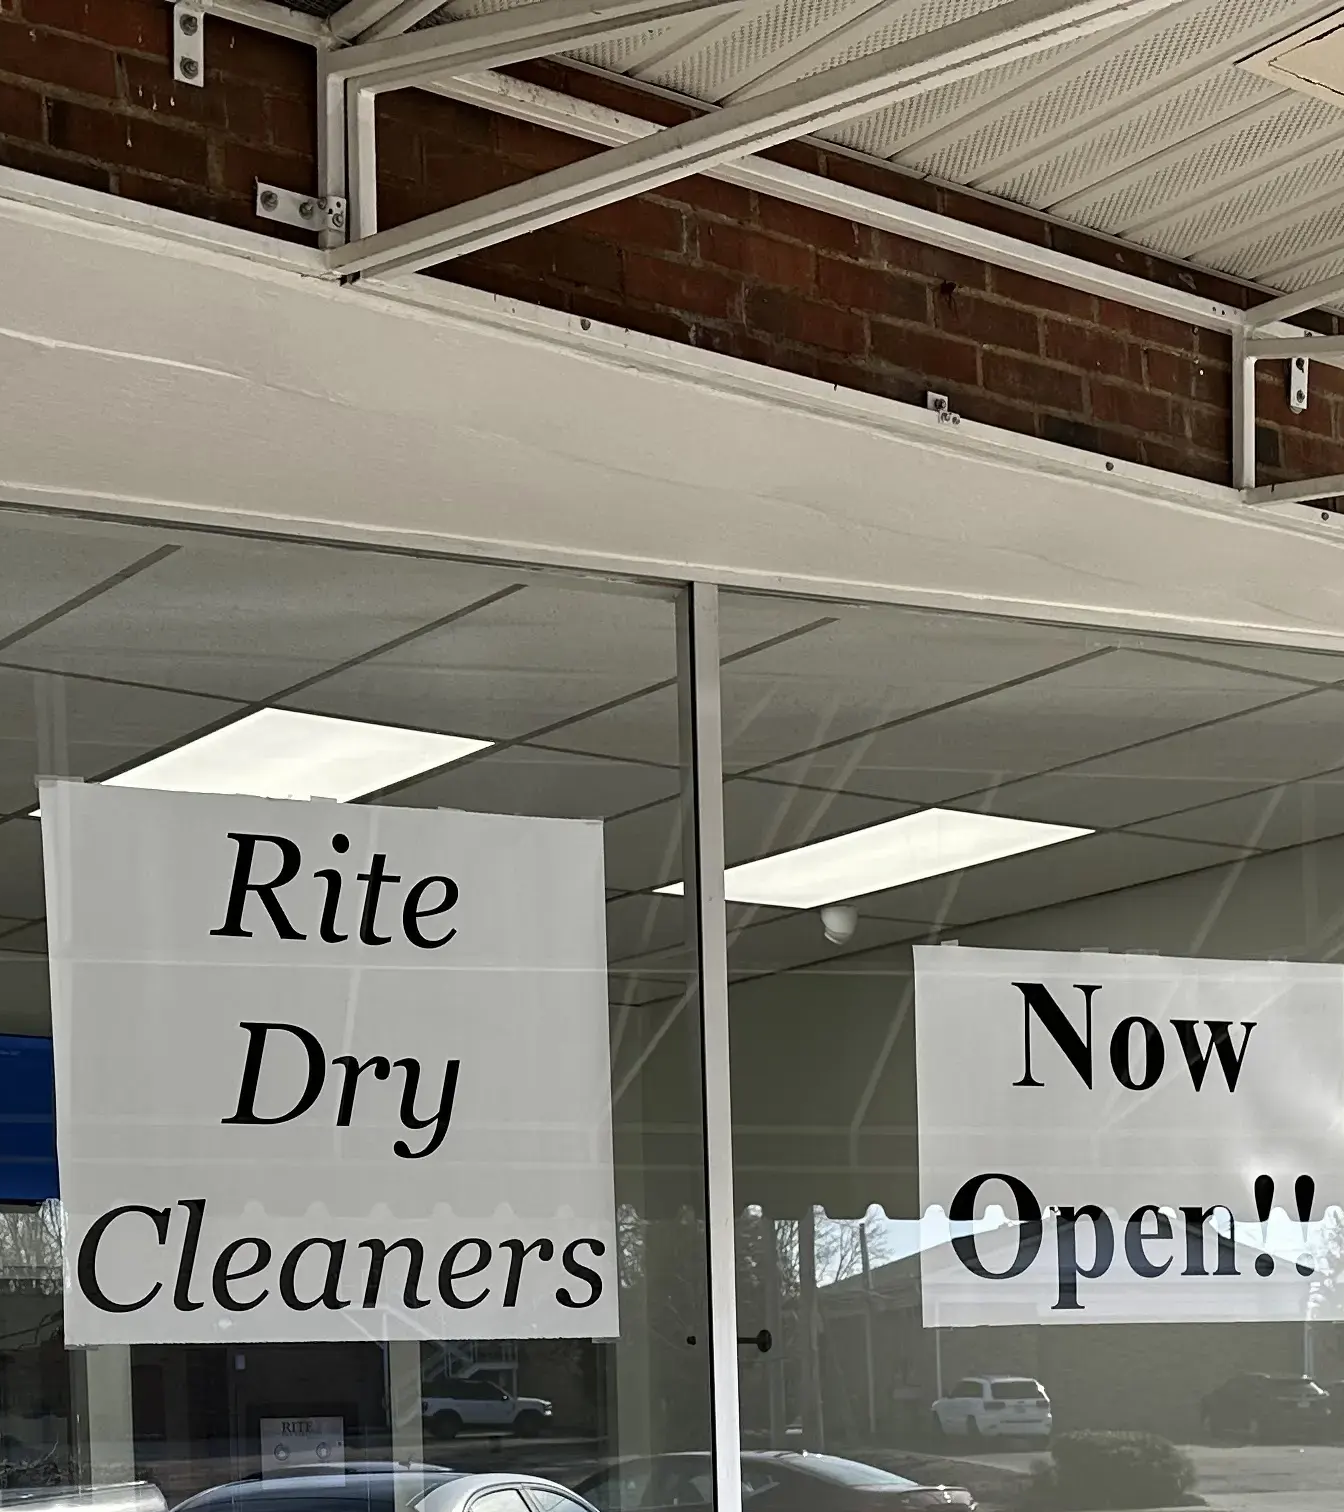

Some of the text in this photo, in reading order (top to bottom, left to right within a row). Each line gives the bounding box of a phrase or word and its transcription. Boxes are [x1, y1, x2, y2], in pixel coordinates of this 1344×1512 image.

[209, 832, 460, 949] Rite
[221, 1021, 460, 1159] Dry
[1011, 982, 1258, 1093] Now
[77, 1199, 606, 1313] Cleaners
[948, 1172, 1316, 1310] Open!!
